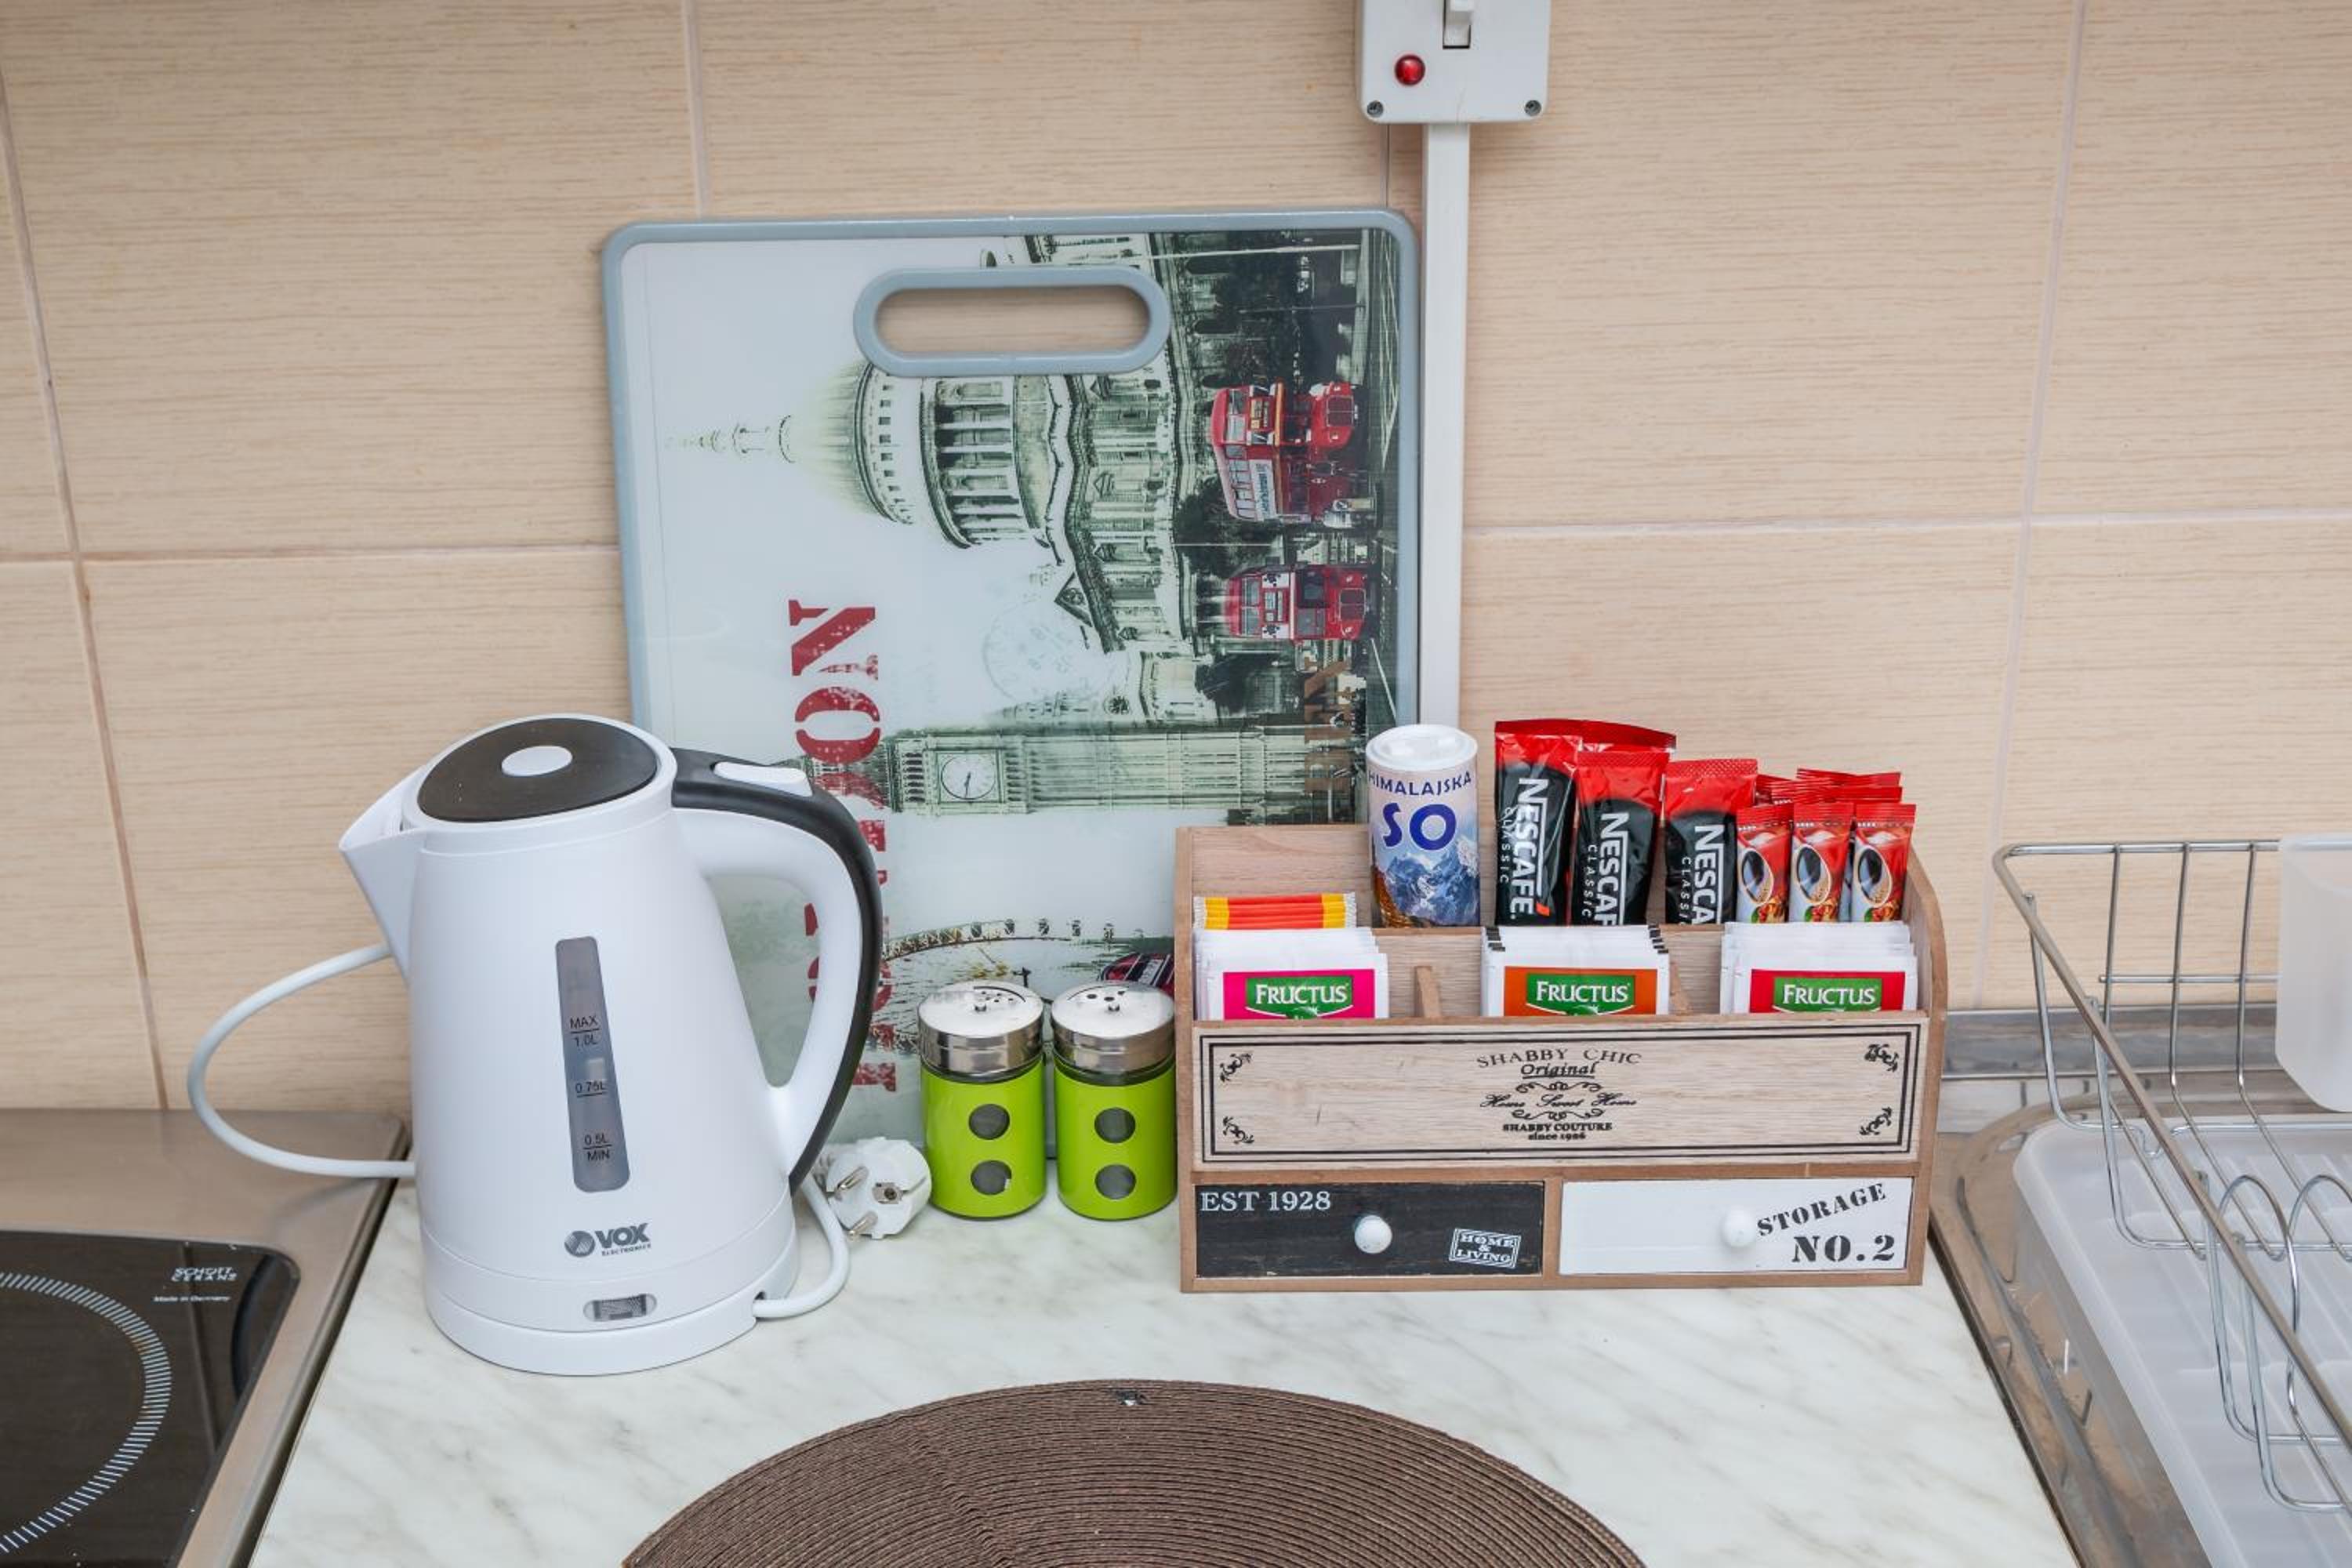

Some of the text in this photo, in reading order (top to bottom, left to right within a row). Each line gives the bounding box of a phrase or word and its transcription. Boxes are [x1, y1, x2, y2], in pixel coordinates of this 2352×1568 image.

[1368, 768, 1472, 797] HIMALAJSKA
[1594, 811, 1631, 926] NESCAF
[1581, 844, 1598, 917] CLASSIC
[1255, 982, 1349, 1005] FRUCTUS
[1536, 980, 1630, 1004] FRUCTUS
[1782, 984, 1878, 1005] FRUCTUS
[569, 1015, 598, 1029] MAX
[1477, 1048, 1642, 1069] SHABBY CHIC
[1519, 1061, 1600, 1079] Original
[1503, 1122, 1613, 1132] SHABBY COUTURE
[587, 1149, 610, 1162] MIN
[1200, 1191, 1331, 1211] EST 1928
[1757, 1183, 1886, 1236] STORAGE
[594, 1222, 650, 1249] VOX
[1460, 1234, 1515, 1247] HOME
[1457, 1249, 1512, 1264] LIVING
[1791, 1235, 1895, 1263] NO.2
